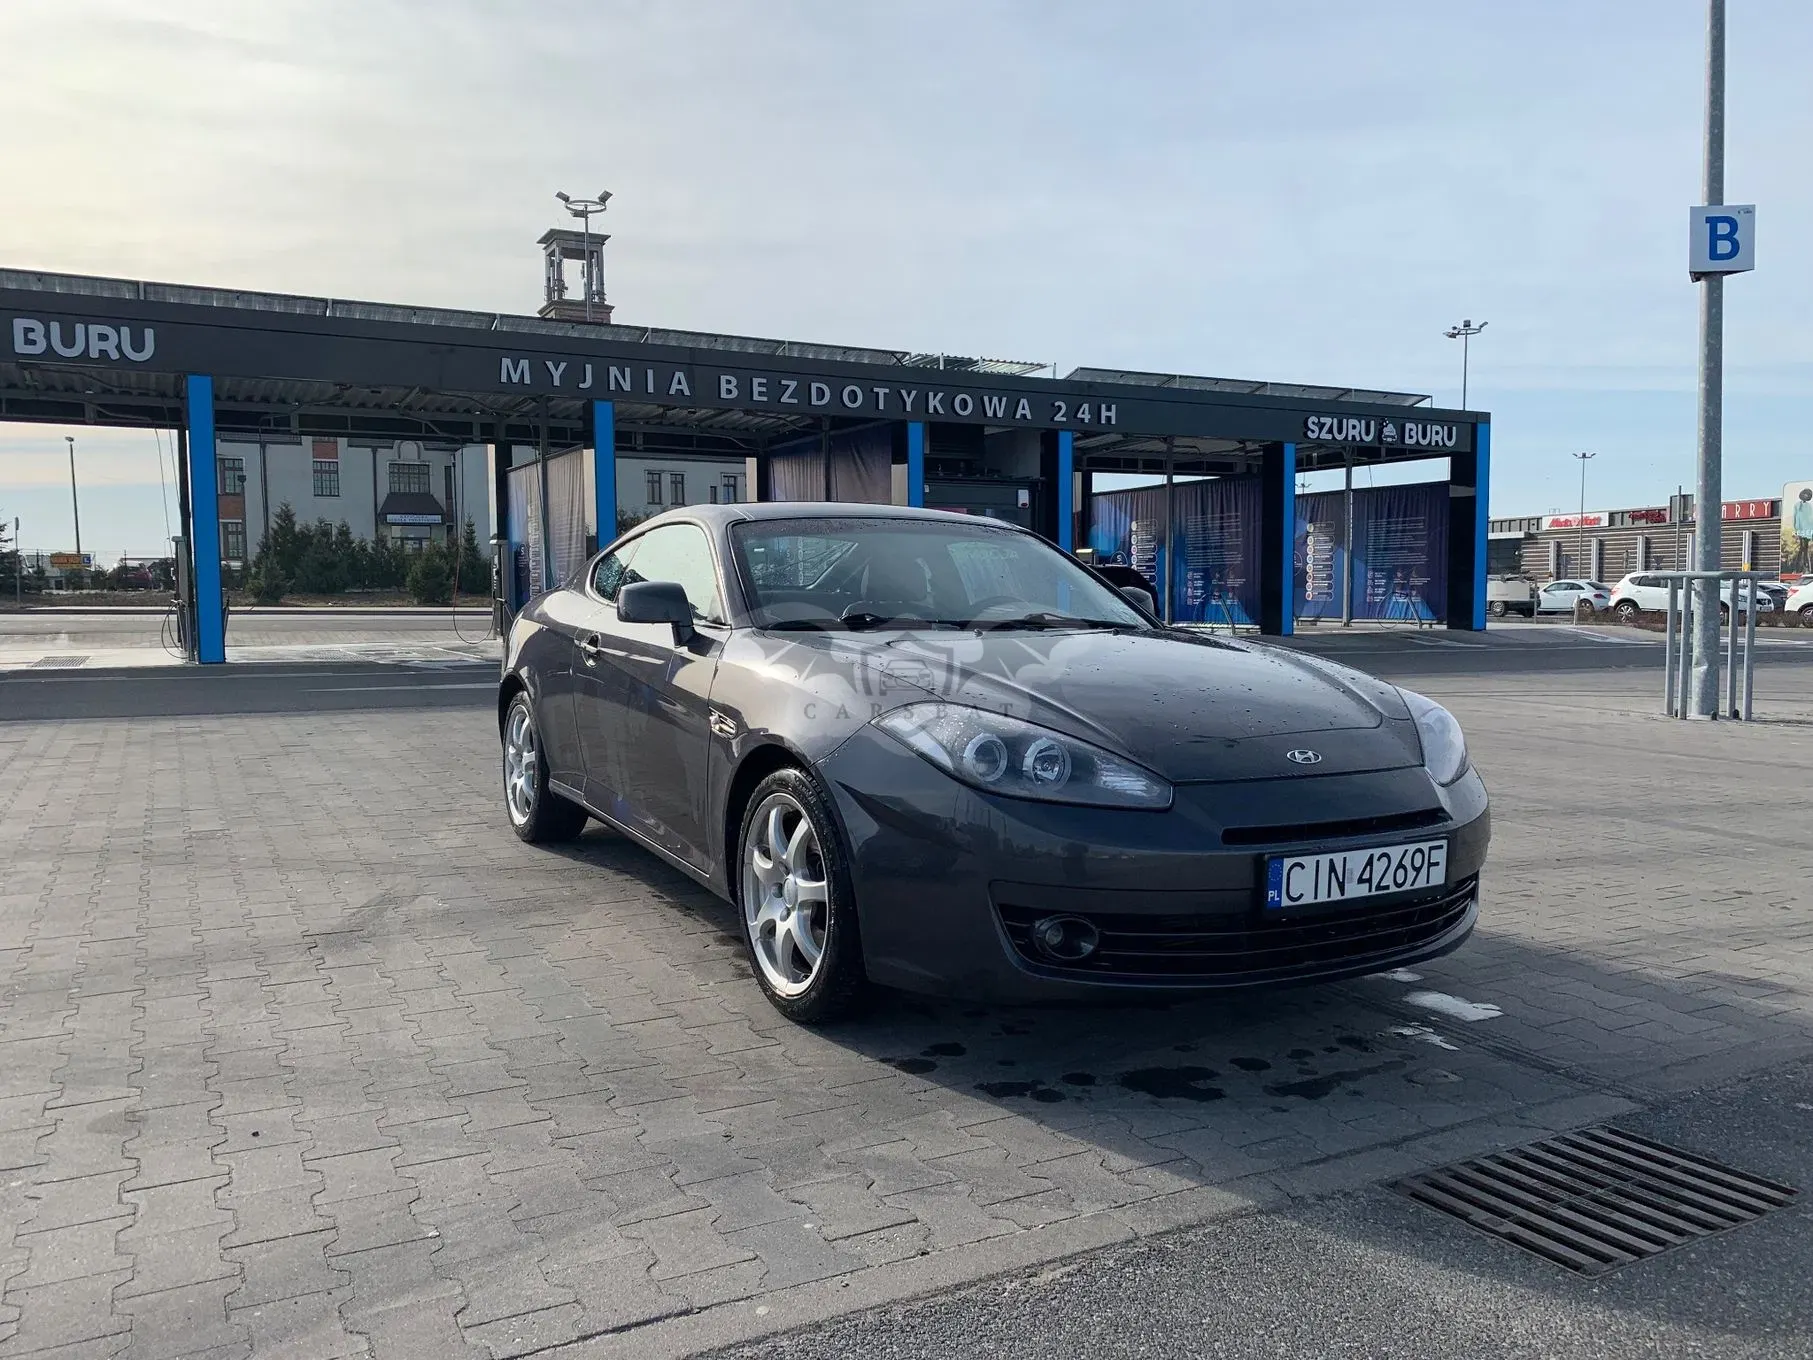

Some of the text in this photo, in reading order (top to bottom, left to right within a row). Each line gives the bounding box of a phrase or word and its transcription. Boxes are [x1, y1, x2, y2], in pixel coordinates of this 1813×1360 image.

[1704, 215, 1740, 261] B
[12, 317, 155, 362] BURU
[500, 357, 1117, 425] MYJNIA BEZDOTYKOWA 24H
[1307, 415, 1457, 447] SZURU BURU
[1267, 889, 1281, 902] PL
[1285, 844, 1445, 903] CIN 4269F
